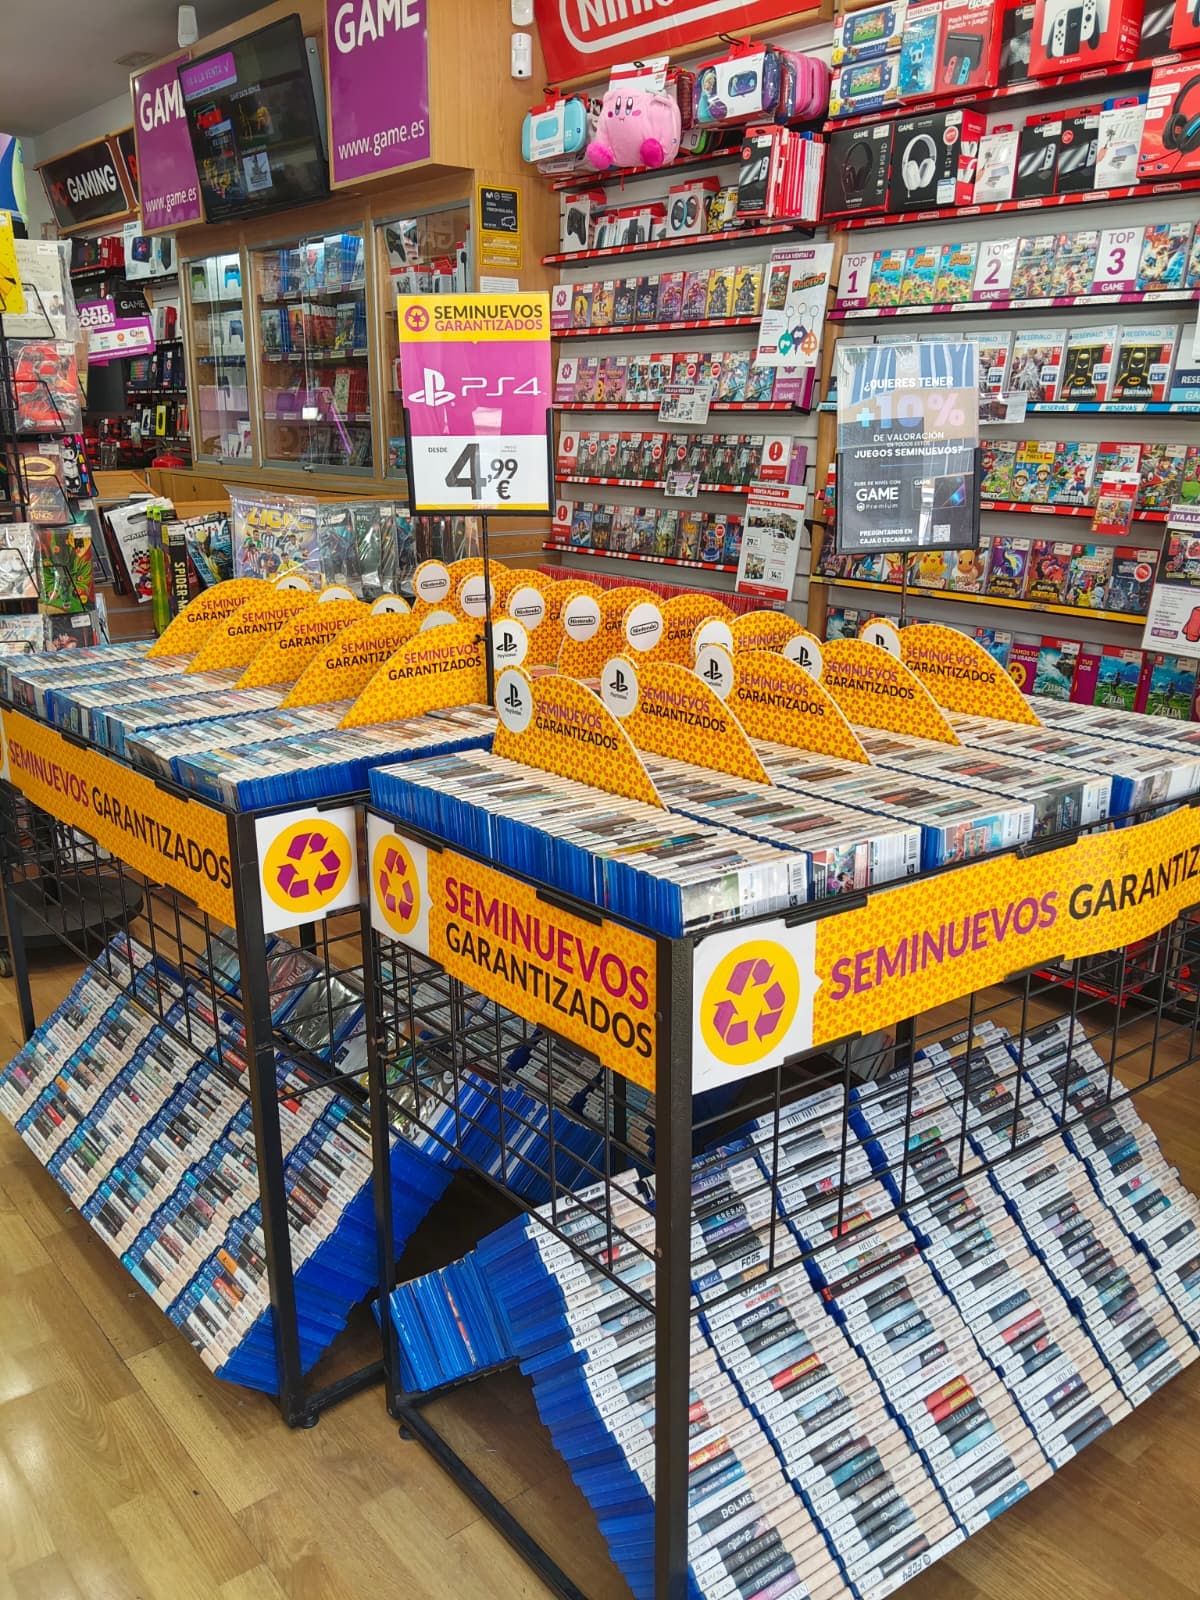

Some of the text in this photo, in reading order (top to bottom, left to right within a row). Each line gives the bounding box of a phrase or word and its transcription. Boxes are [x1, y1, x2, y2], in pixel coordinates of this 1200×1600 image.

[334, 0, 420, 53] GAME
[338, 119, 425, 160] www.game.es
[66, 164, 117, 203] GAMING
[145, 187, 197, 213] www.game.es
[1109, 232, 1135, 245] TOP
[847, 257, 867, 267] TOP
[984, 259, 1001, 285] 2
[1106, 248, 1126, 275] 3
[847, 271, 858, 294] 1
[1101, 282, 1125, 291] GAME
[120, 301, 145, 310] GAME
[842, 298, 860, 307] GAME
[980, 291, 1000, 300] GAME
[80, 305, 109, 317] AZTE
[434, 304, 543, 320] SEMINUEVOS
[434, 318, 543, 332] GARANTIZADOS
[461, 377, 542, 397] PS4
[864, 376, 953, 393] ¿QUIERES TENER
[873, 434, 884, 442] DE
[854, 446, 962, 459] JUEGOS SEMINUEVOS?
[856, 487, 899, 501] GAME
[174, 562, 188, 613] SPIDER-M
[633, 624, 657, 633] Nintendo
[404, 643, 479, 665] SEMINUEVOS
[906, 647, 978, 667] SEMINUEVOS
[388, 656, 481, 681] GARANTIZADOS
[827, 660, 897, 683] SEMINUEVOS
[905, 660, 996, 684] GARANTIZADOS
[738, 672, 808, 697] SEMINUEVOS
[825, 674, 914, 699] GARANTIZADOS
[642, 687, 710, 713] SEMINUEVOS
[738, 688, 825, 716] GARANTIZADOS
[536, 700, 602, 730] SEMINUEVOS
[641, 702, 726, 733] GARANTIZADOS
[535, 716, 618, 750] GARANTIZADOS
[9, 739, 232, 889] SEMINUEVOS GARANTIZADOS
[830, 845, 1200, 1000] SEMINUEVOS GARANTIZ
[445, 877, 649, 1010] SEMINUEVOS
[446, 923, 652, 1058] GARANTIZADOS
